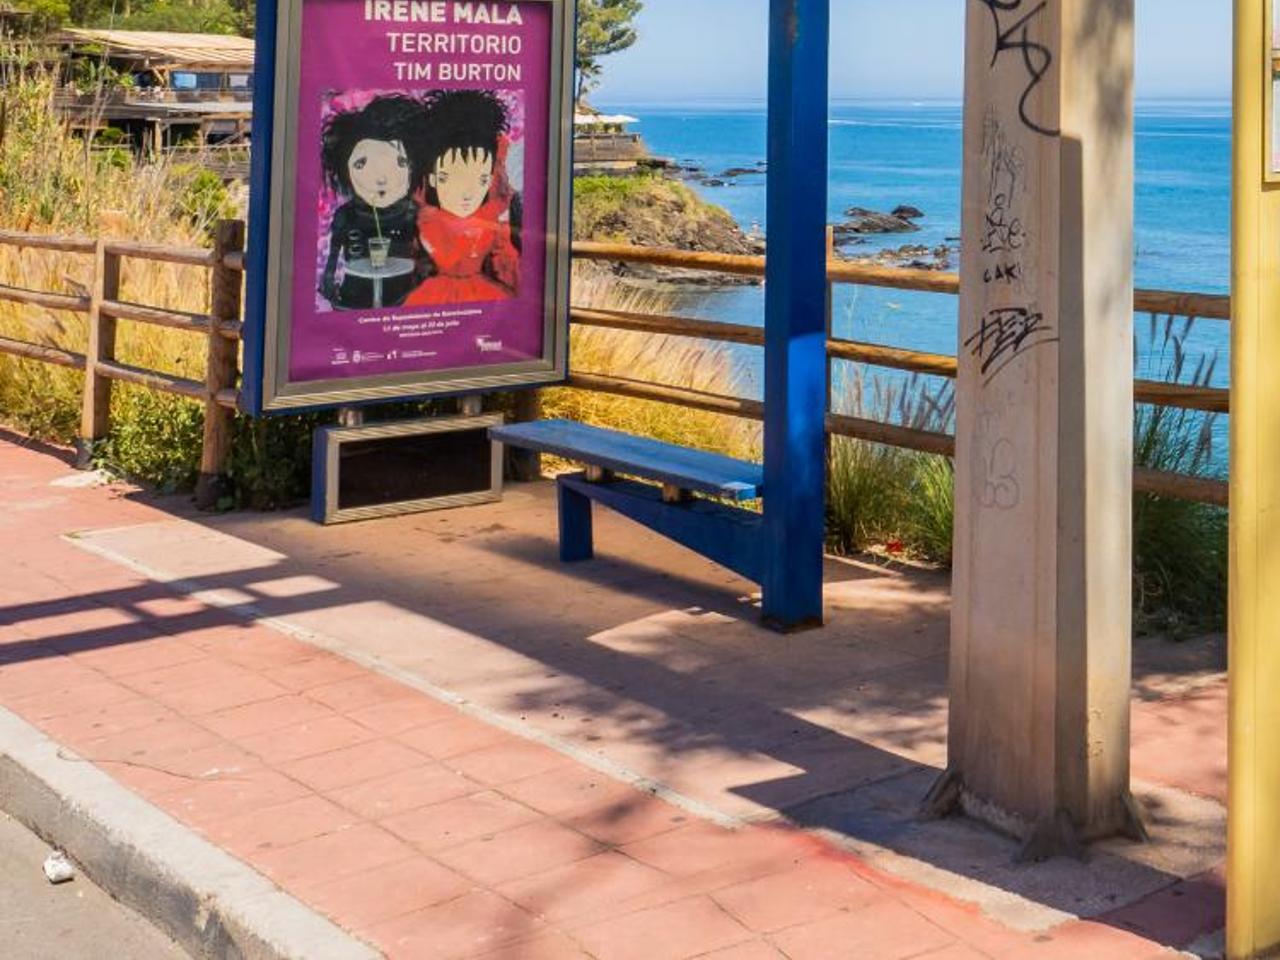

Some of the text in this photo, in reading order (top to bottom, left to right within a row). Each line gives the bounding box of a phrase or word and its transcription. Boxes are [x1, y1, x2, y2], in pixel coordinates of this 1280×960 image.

[453, 1, 524, 25] MALA
[386, 32, 522, 55] TERRITORIO
[394, 61, 522, 82] TIM BURTON
